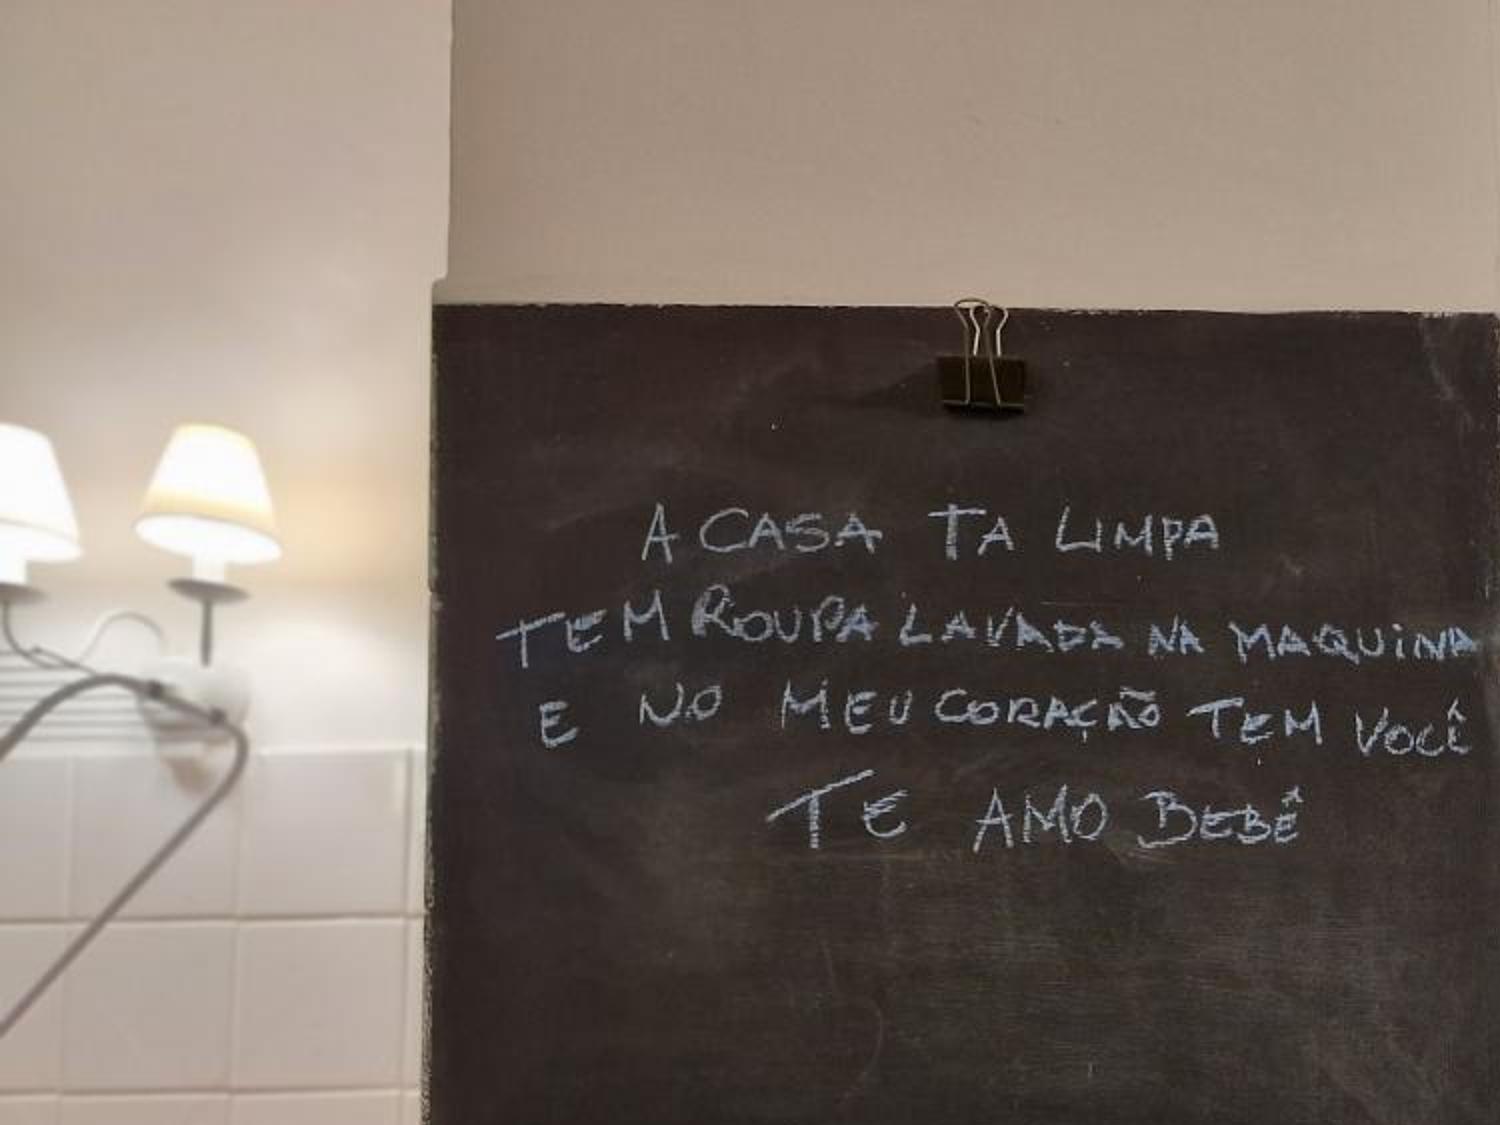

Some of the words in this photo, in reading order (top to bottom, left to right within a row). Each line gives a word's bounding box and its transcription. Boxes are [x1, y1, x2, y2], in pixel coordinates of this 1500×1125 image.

[641, 502, 679, 564] A
[699, 507, 883, 554] CASA
[928, 502, 1016, 561] TA
[1055, 505, 1220, 561] LIMPA
[496, 590, 670, 668] TEM
[691, 583, 878, 643] ROUPA
[899, 605, 1123, 653] LAVADA
[1146, 615, 1204, 656] NA
[538, 700, 579, 748] E
[639, 682, 722, 727] NO
[781, 681, 913, 734] MEU
[1186, 697, 1323, 745] TEM
[765, 769, 908, 849] TE
[972, 784, 1108, 853] AMO
